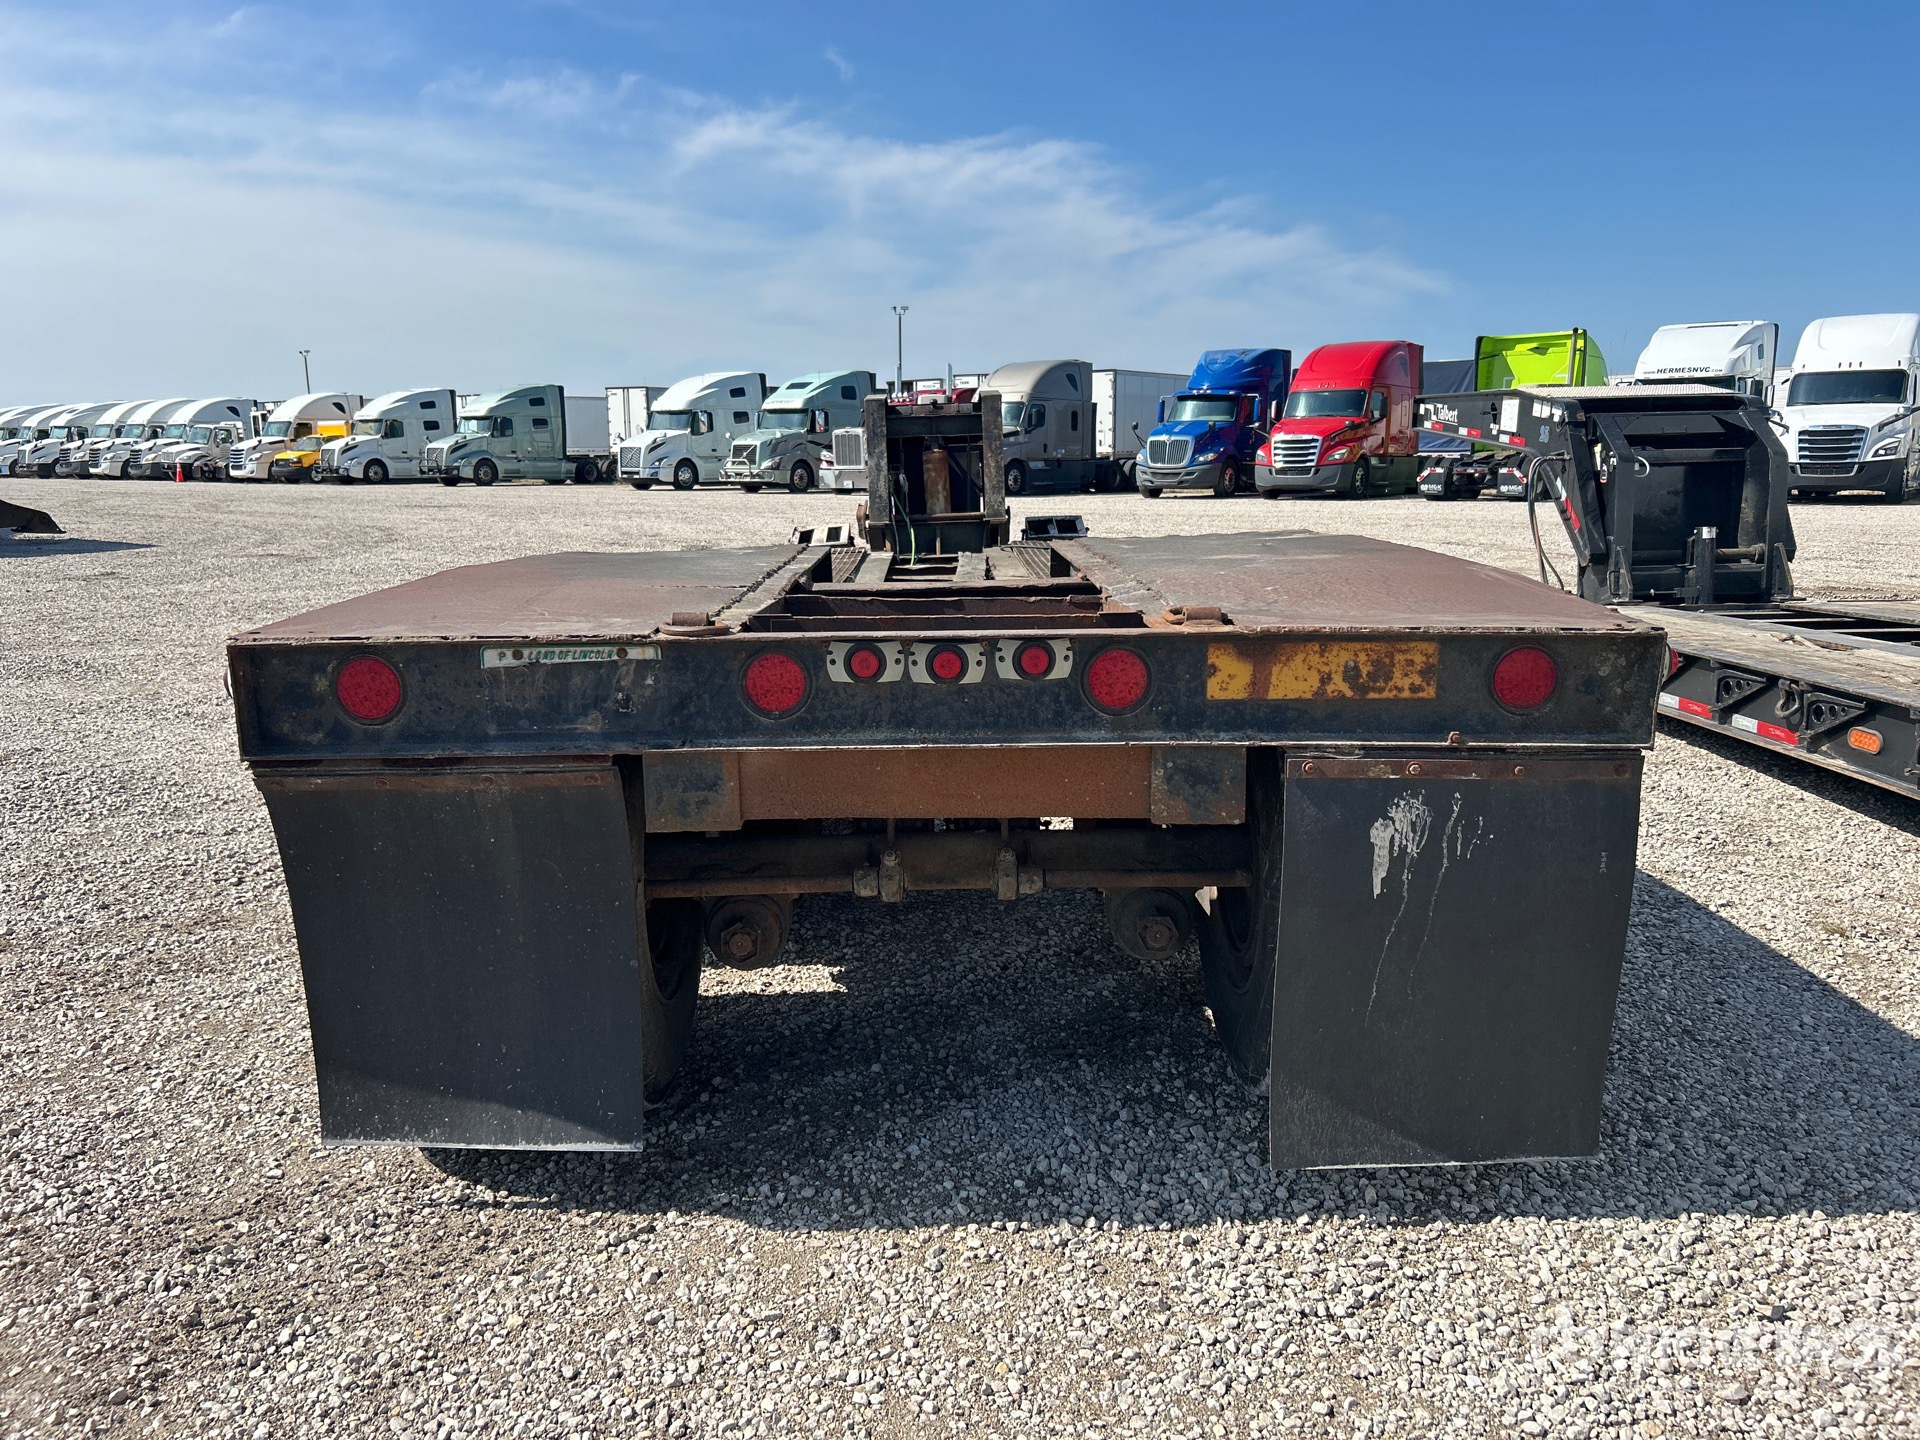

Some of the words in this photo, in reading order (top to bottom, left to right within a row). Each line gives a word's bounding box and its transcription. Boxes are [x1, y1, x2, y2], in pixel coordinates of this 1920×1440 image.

[1437, 403, 1458, 423] Talbert
[528, 650, 556, 661] LAND
[558, 650, 573, 660] OF
[572, 650, 615, 660] LINCOLN
